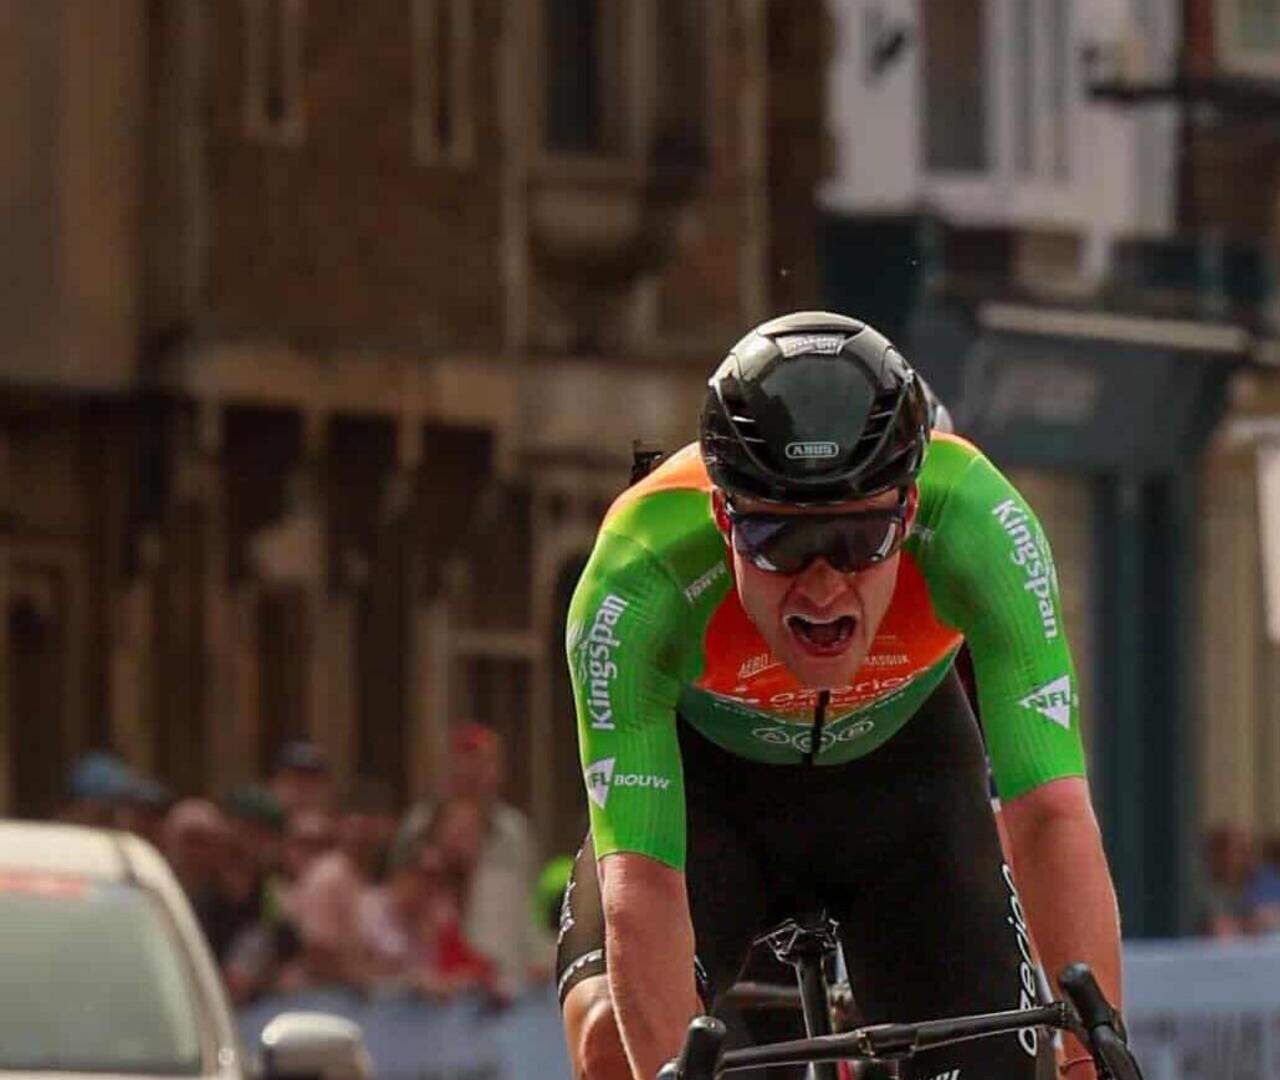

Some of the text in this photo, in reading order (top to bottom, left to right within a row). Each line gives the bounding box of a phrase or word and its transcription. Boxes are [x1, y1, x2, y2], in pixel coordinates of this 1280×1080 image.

[993, 499, 1058, 638] Kingspan
[587, 593, 628, 731] Kingspan
[614, 773, 670, 789] BOUW
